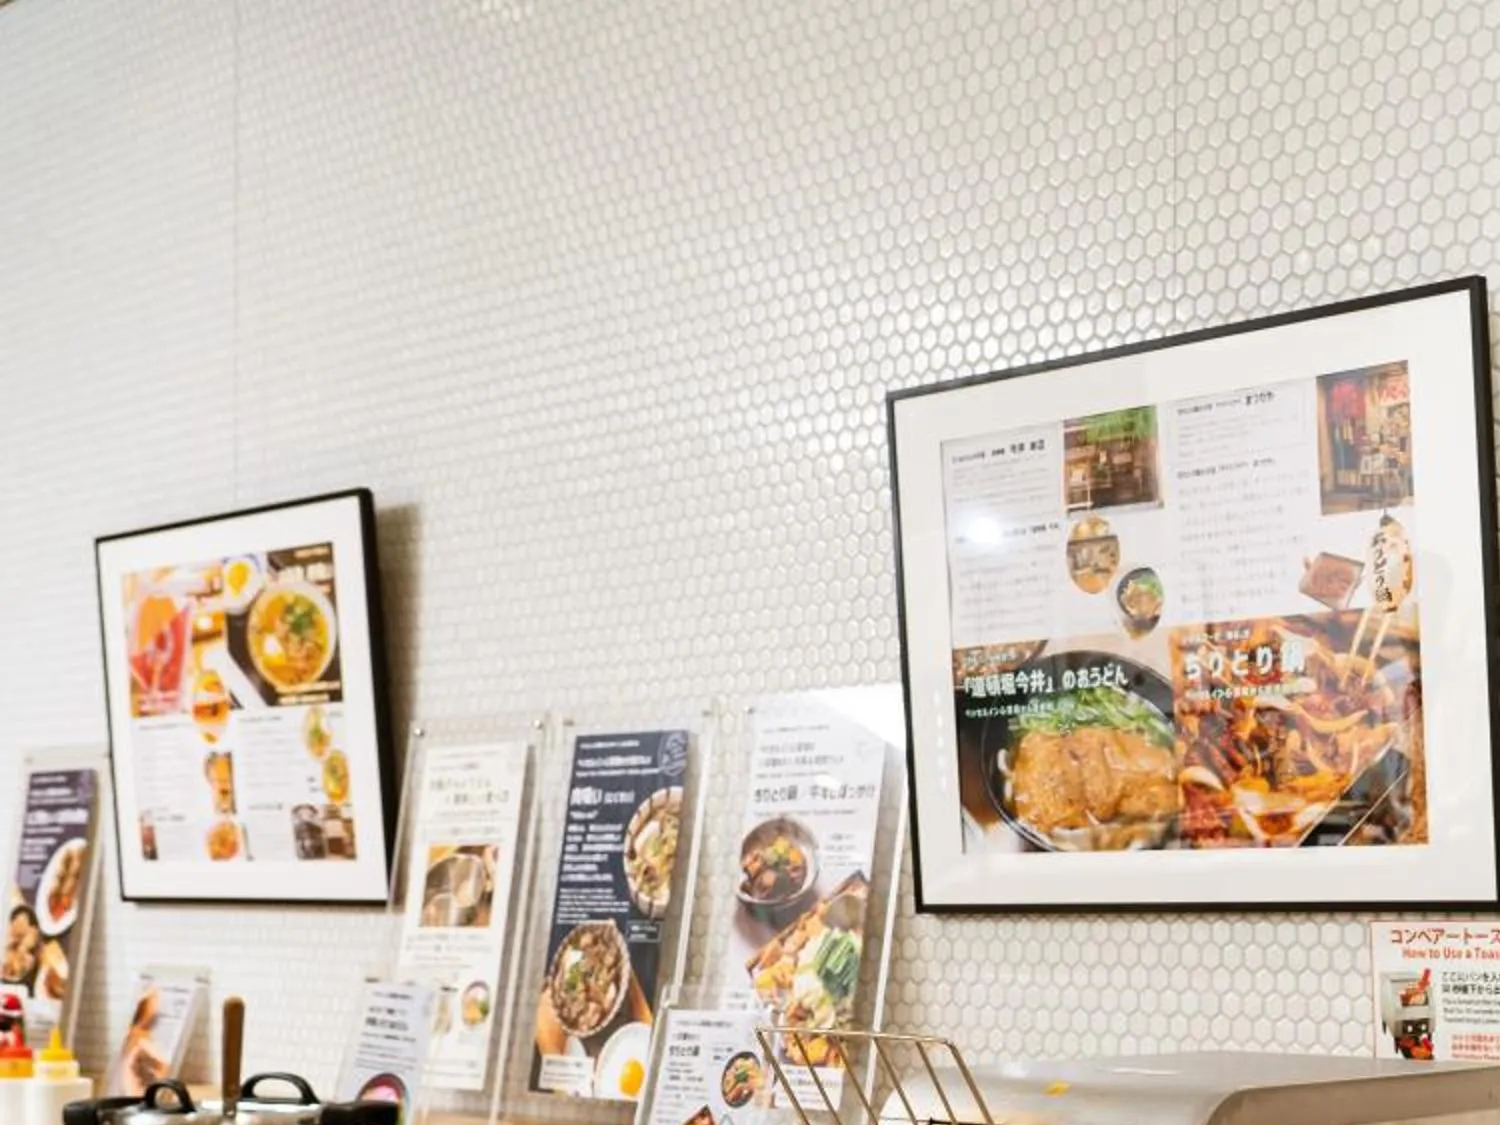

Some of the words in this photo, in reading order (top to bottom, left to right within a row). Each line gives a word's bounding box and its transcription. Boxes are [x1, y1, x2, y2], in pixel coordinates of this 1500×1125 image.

[1402, 949, 1427, 959] How
[1429, 949, 1440, 959] to
[1444, 949, 1462, 959] Use
